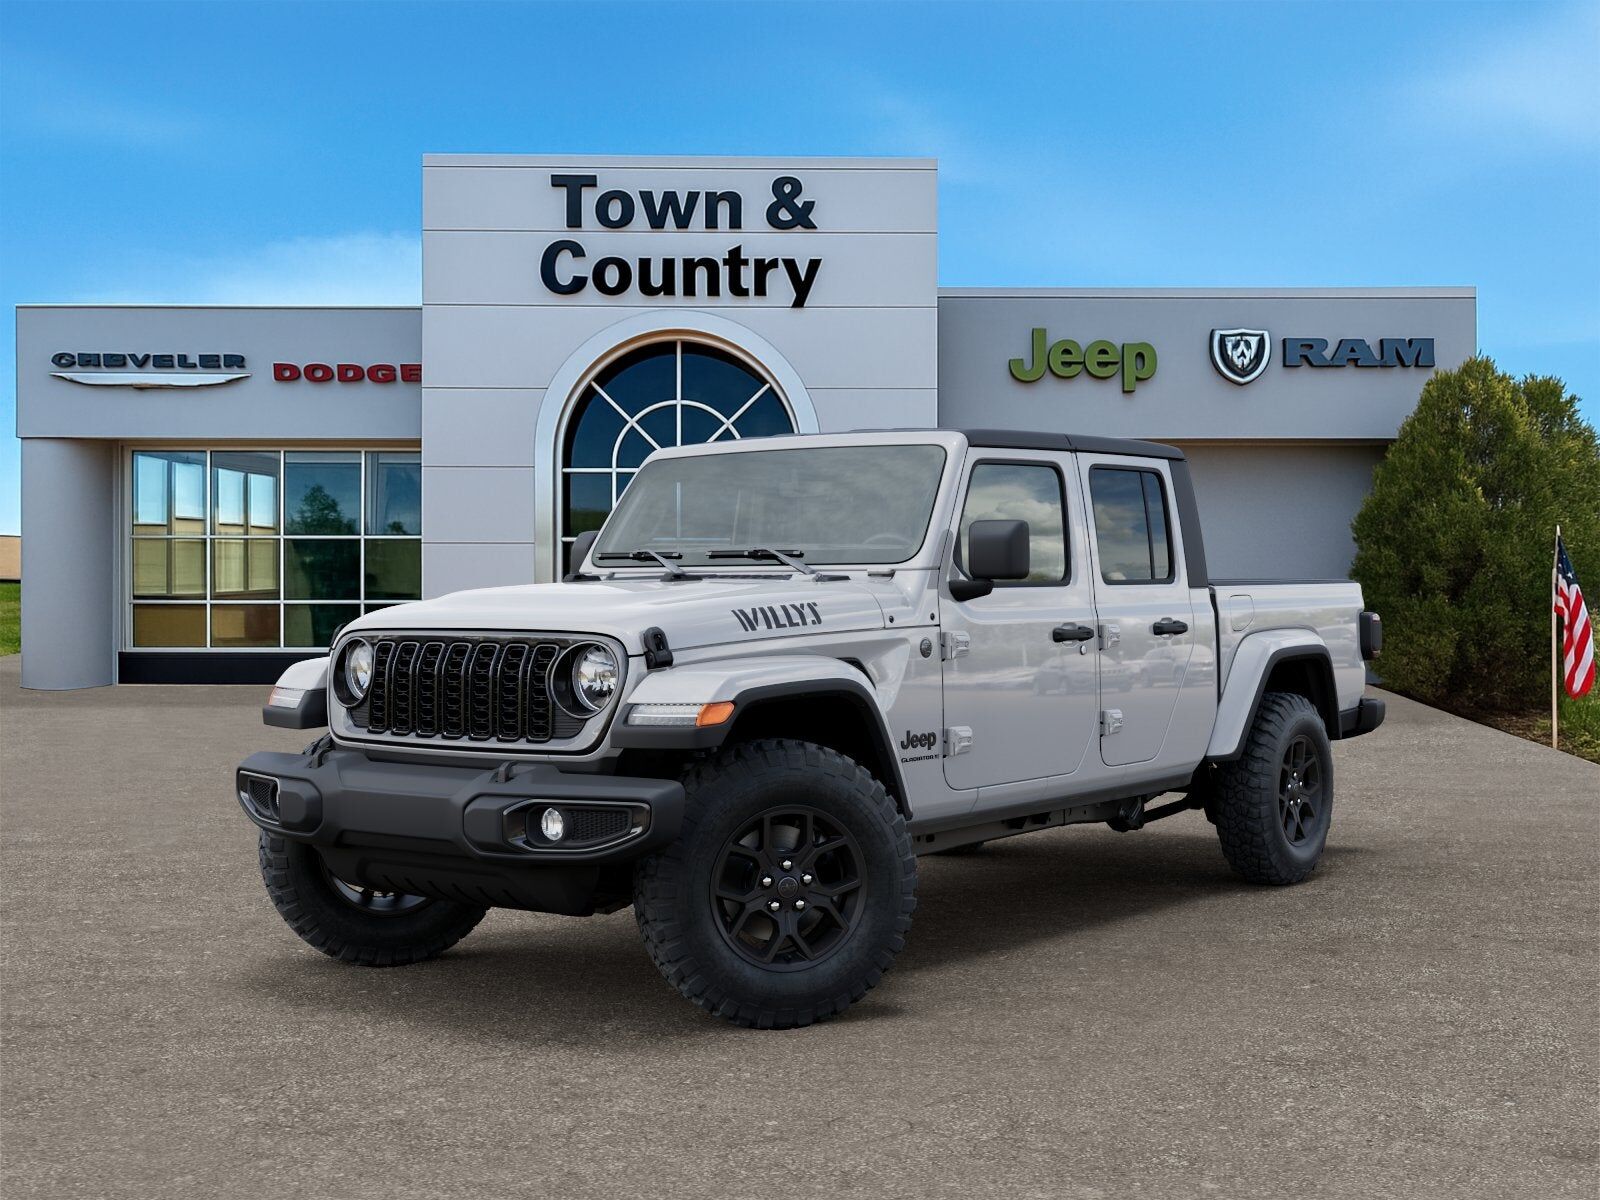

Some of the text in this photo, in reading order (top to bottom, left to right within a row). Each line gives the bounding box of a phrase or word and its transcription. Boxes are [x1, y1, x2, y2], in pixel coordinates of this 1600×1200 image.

[551, 174, 818, 230] Town &
[540, 239, 822, 308] Country
[1009, 328, 1158, 393] Jeep
[1282, 337, 1435, 368] RAM
[273, 362, 421, 383] DODGE
[731, 601, 822, 632] WILLYS
[900, 730, 937, 750] Jeep
